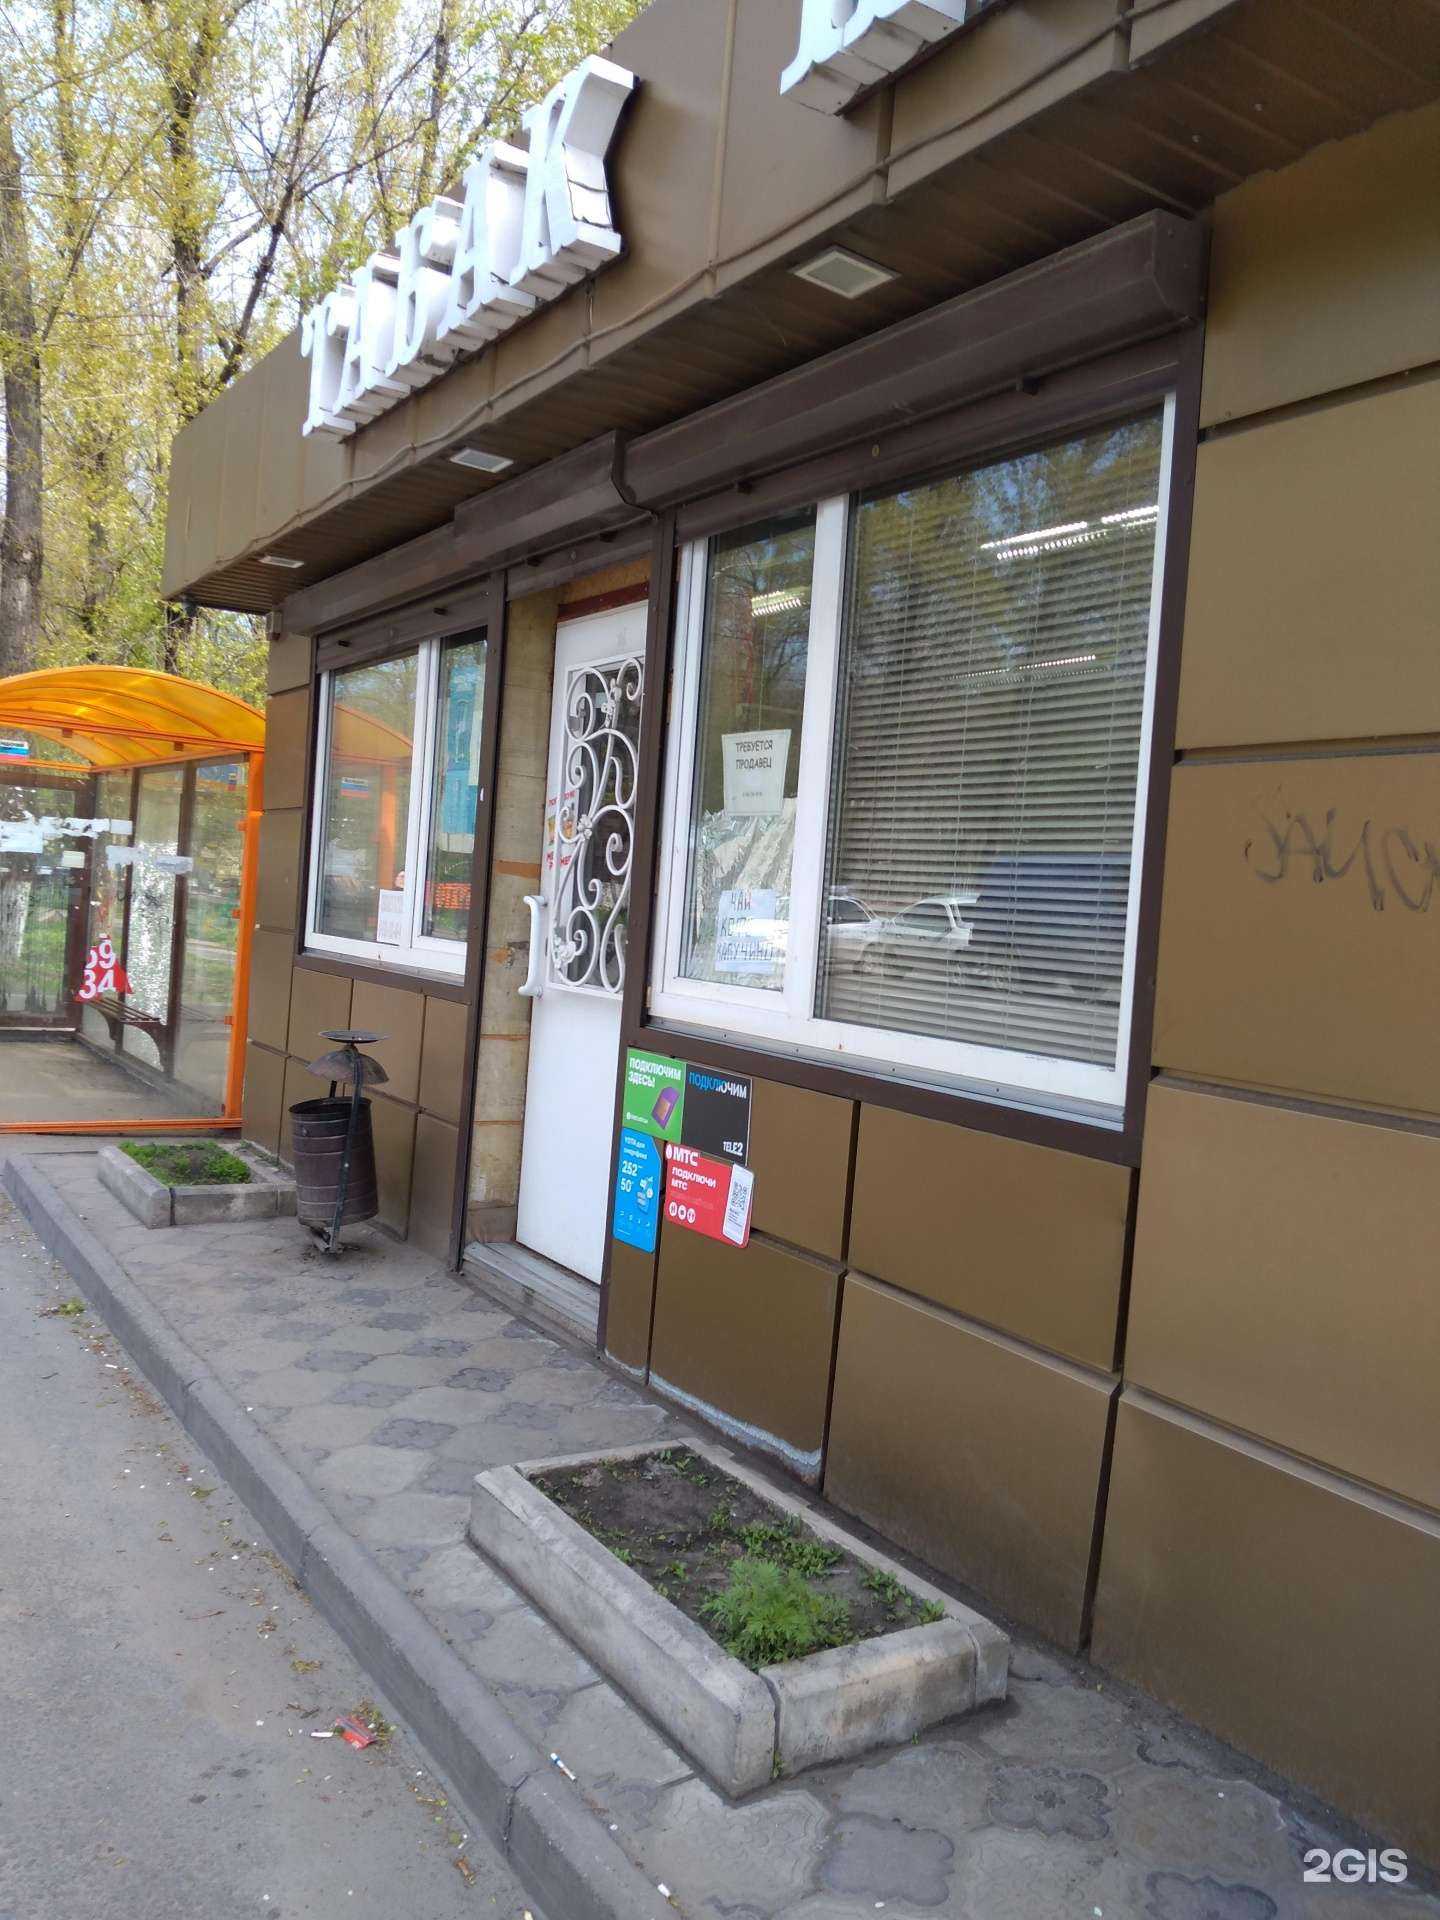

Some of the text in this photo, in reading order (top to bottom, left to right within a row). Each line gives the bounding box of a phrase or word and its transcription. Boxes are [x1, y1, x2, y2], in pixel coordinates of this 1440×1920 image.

[301, 54, 636, 438] ТАБАК
[735, 739, 774, 754] ТРЕБУЕТСЯ
[735, 757, 773, 770] ПРОДАВЕЦ
[629, 1056, 681, 1081] ПОДКЛЮЧИМ
[689, 1071, 747, 1099] ПОДКЛЮЧИМ
[672, 1147, 699, 1167] МТС
[723, 1141, 743, 1156] TELE2
[621, 1160, 638, 1177] 252
[620, 1178, 632, 1193] 50
